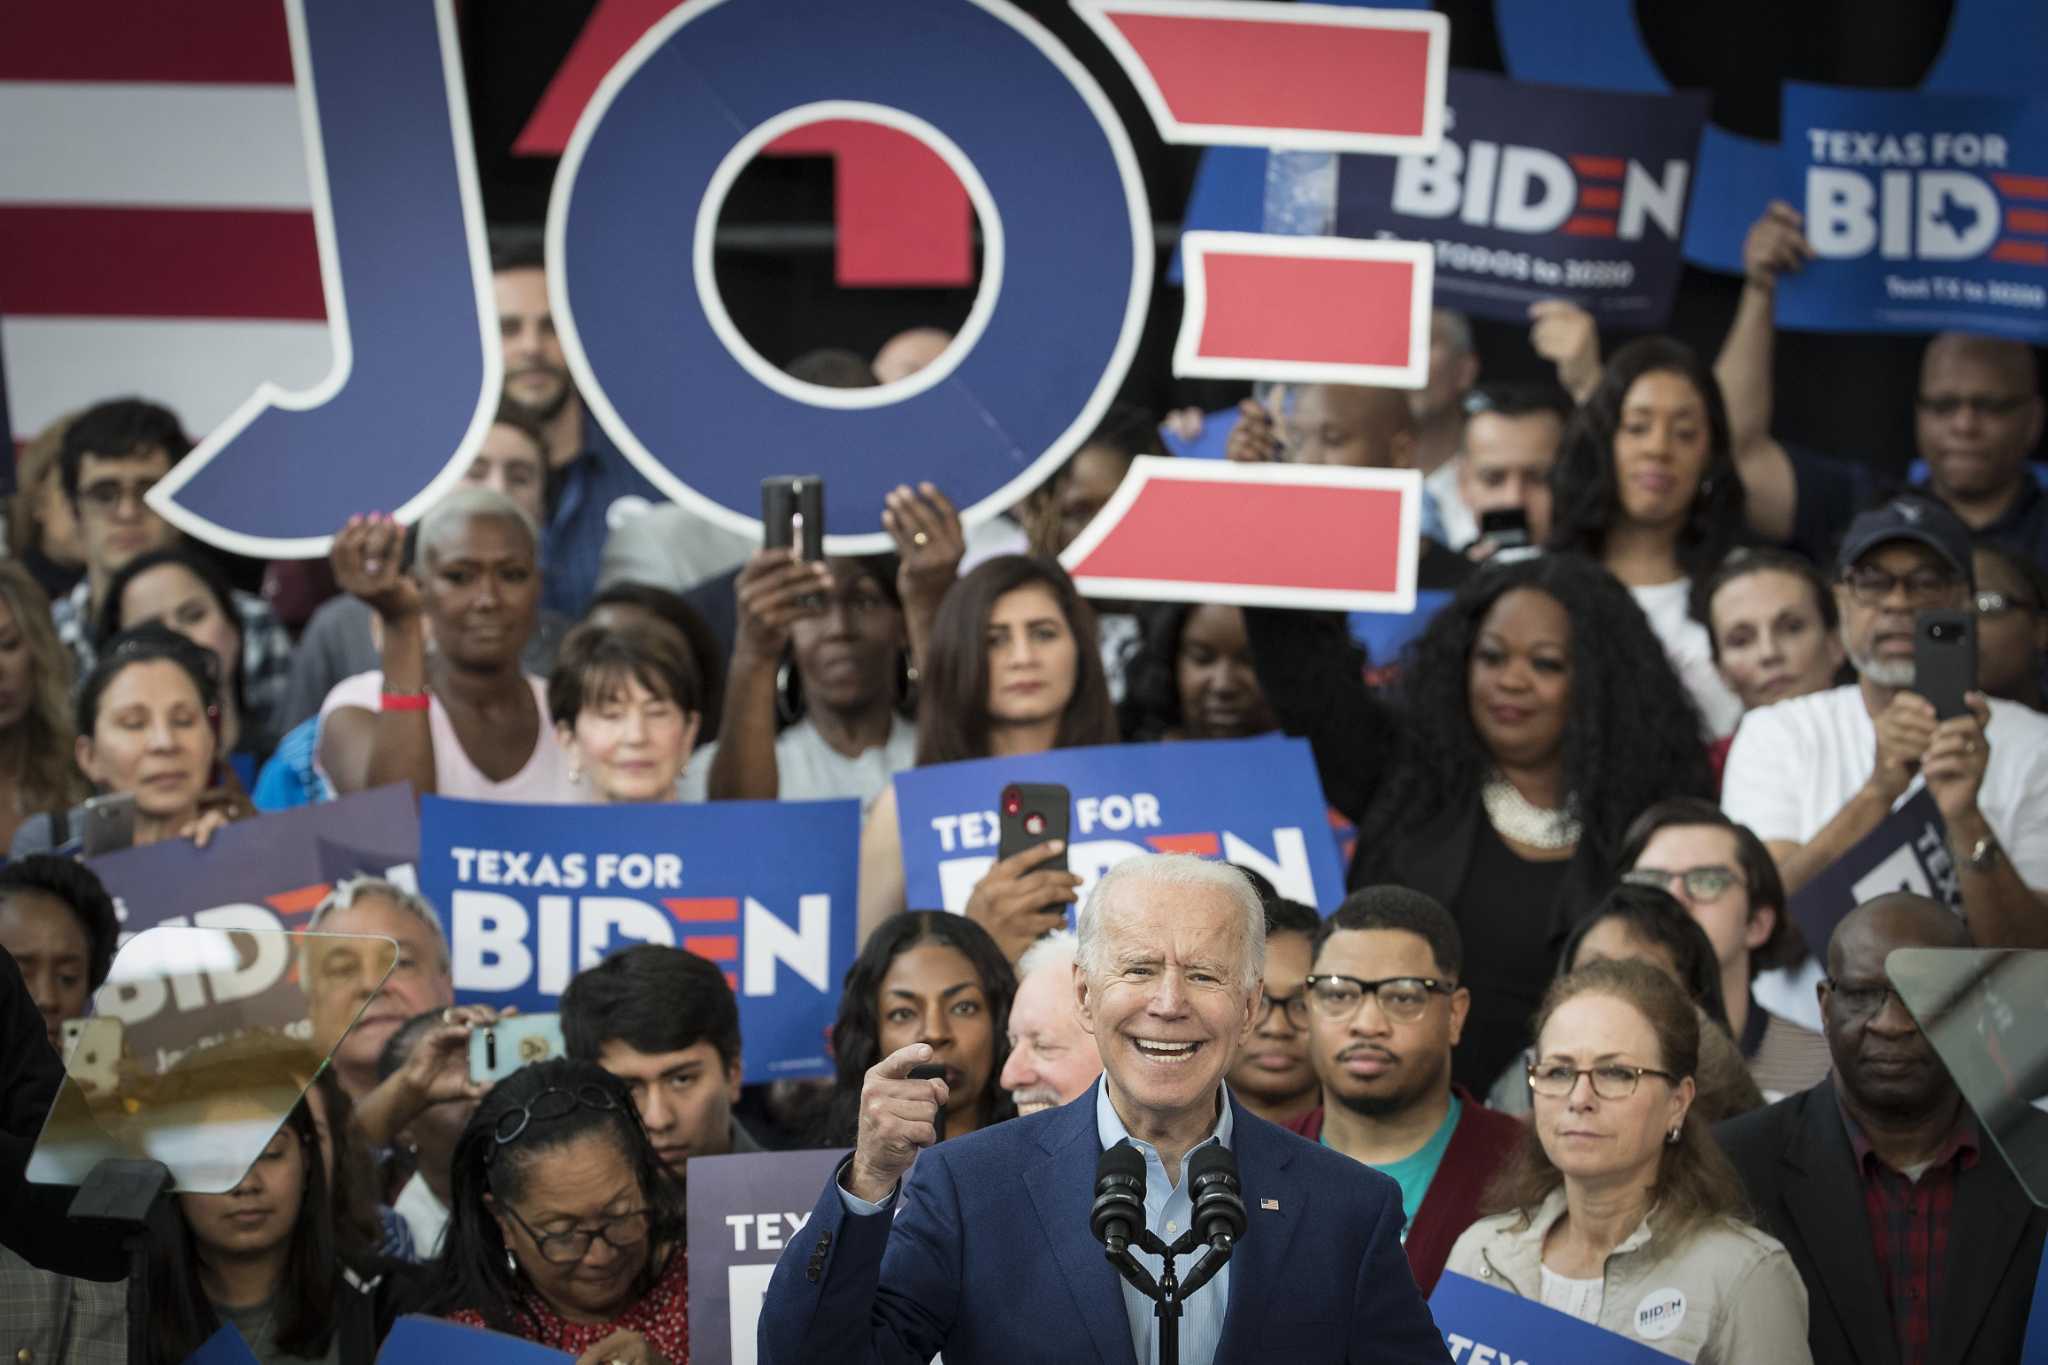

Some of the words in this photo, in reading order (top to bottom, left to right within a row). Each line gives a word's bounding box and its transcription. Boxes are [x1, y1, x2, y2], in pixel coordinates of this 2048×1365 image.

[1807, 127, 1926, 166] TEXAS
[1932, 131, 2009, 168] FOR
[1391, 137, 1690, 242] BIDEN
[1804, 164, 2048, 266] BIDE
[145, 0, 1449, 612] JOE
[931, 811, 1001, 852] TEX
[1076, 792, 1162, 834] FOR
[450, 846, 588, 888] TEXAS
[596, 853, 683, 889] FOR
[450, 889, 831, 998] BIDEN
[725, 1212, 813, 1251] TEX
